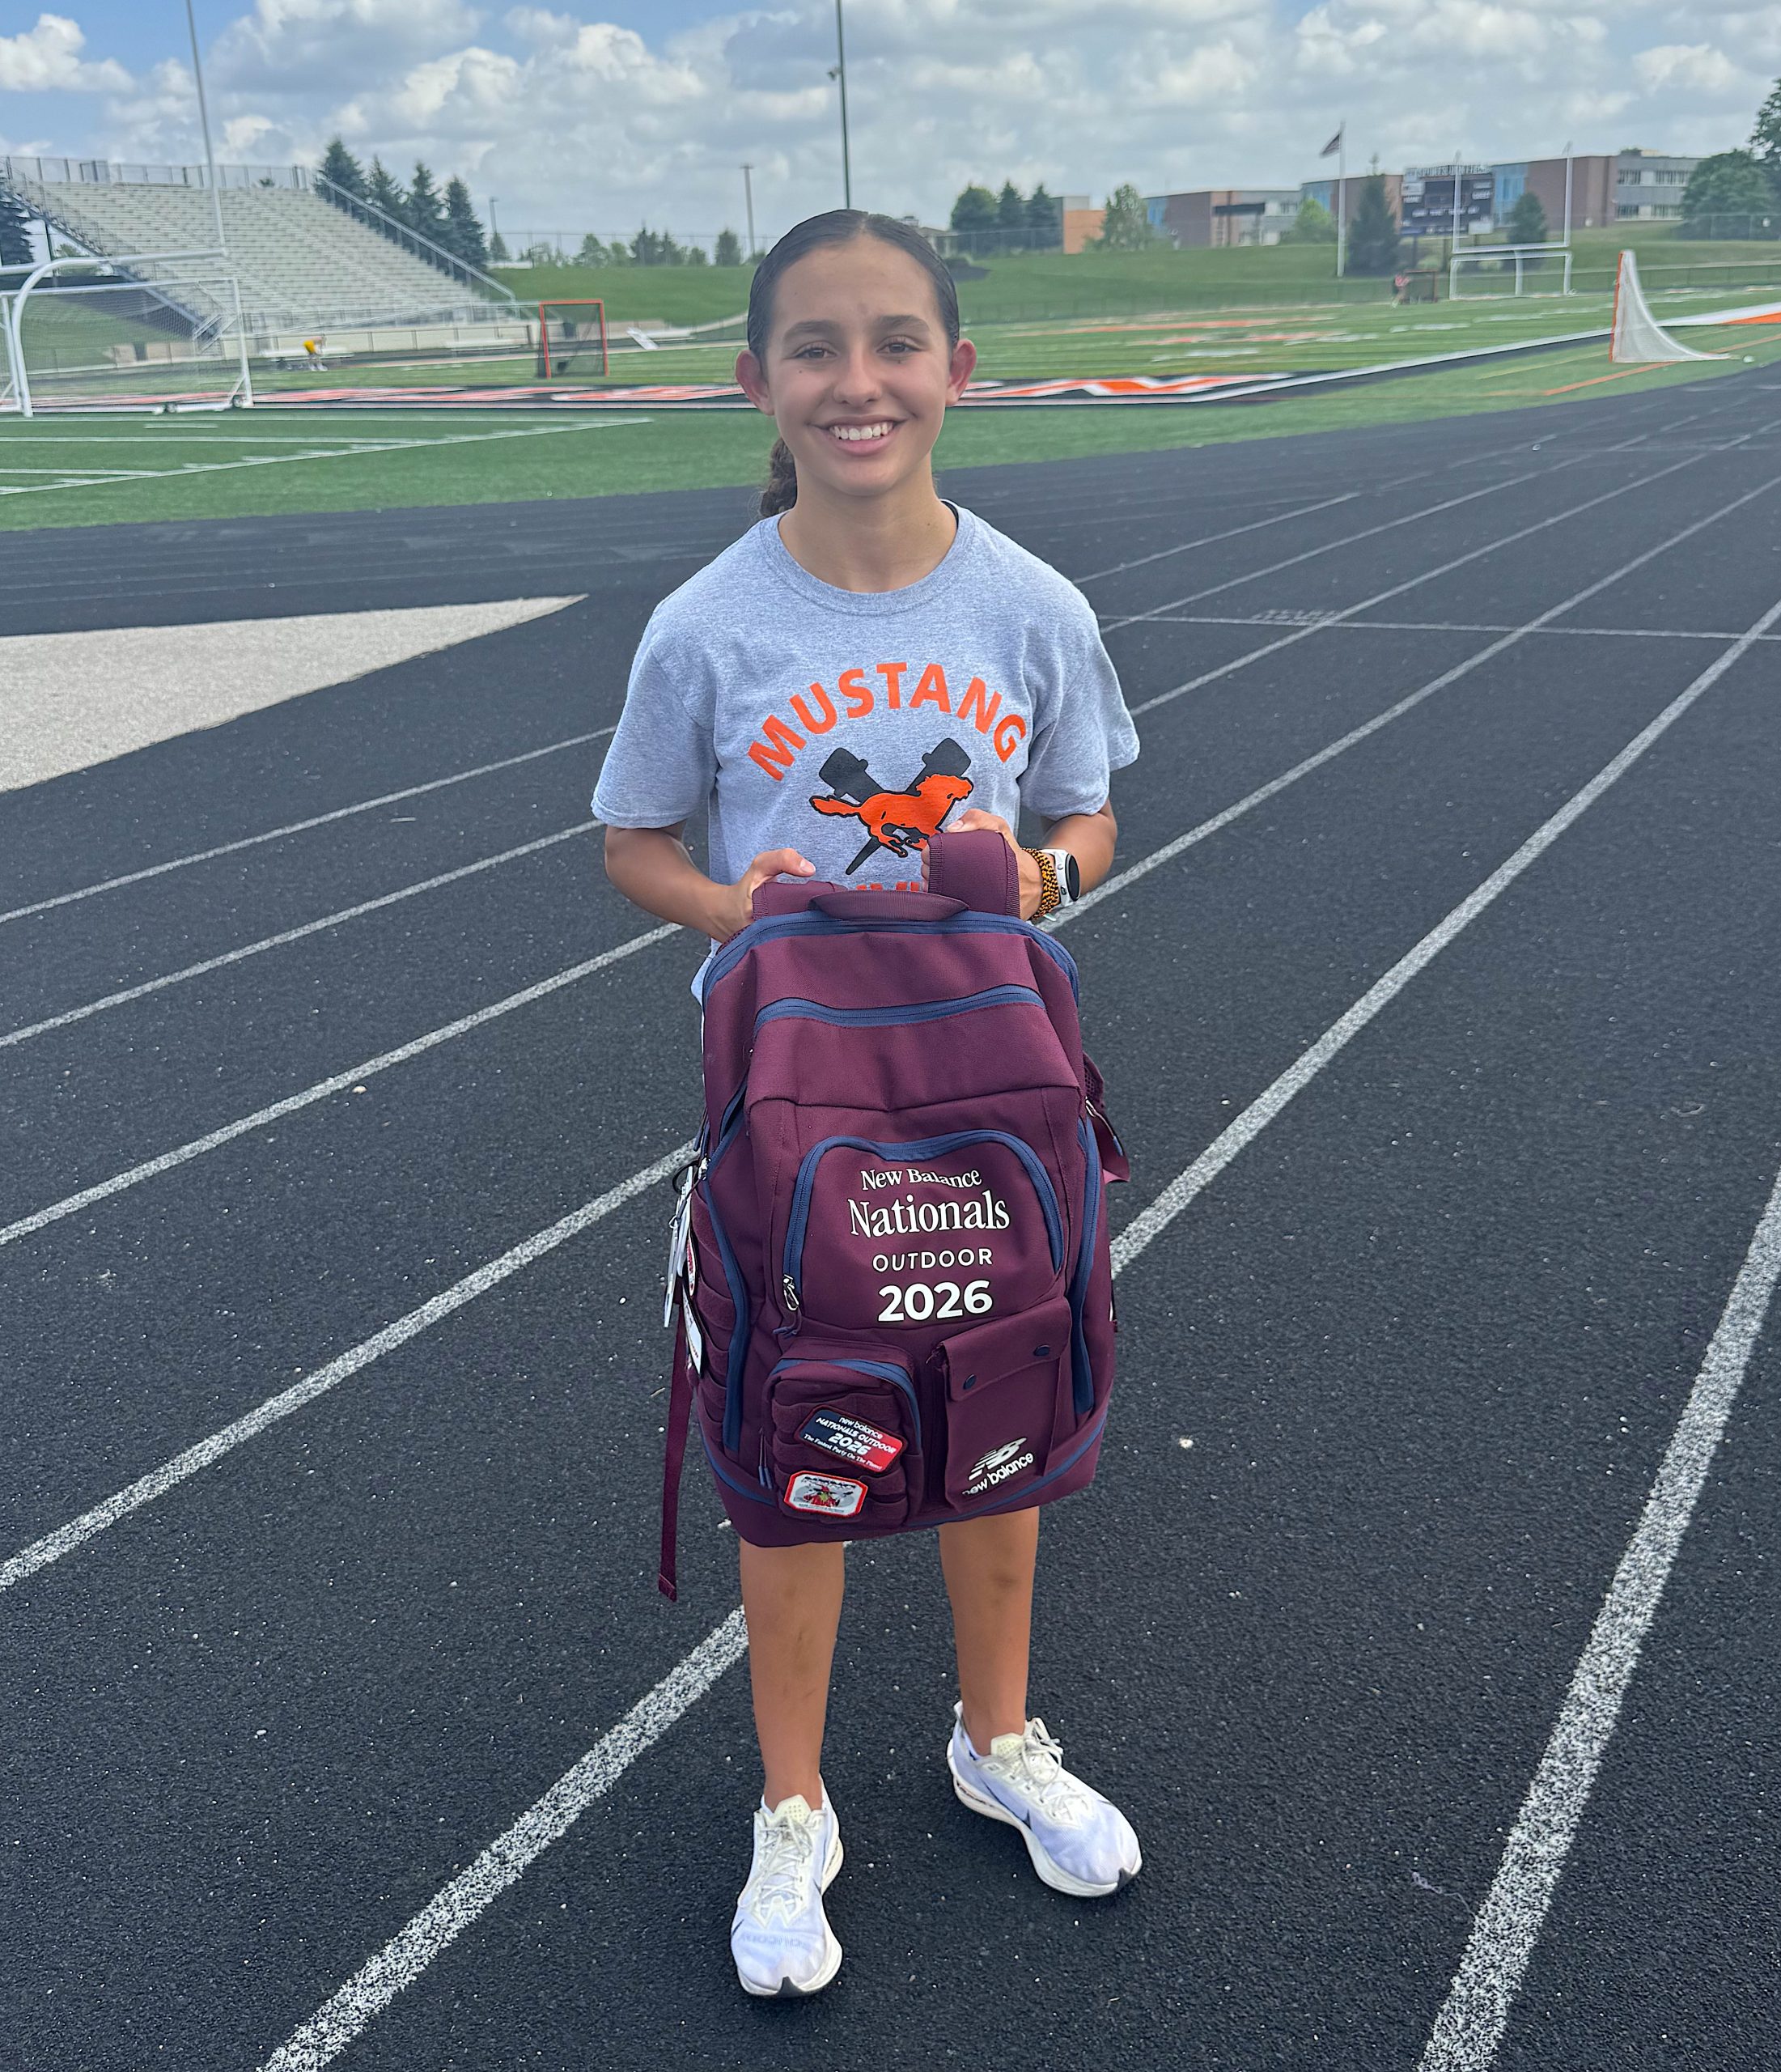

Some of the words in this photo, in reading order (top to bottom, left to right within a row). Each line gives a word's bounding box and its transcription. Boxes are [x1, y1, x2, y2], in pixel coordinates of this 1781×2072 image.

[748, 662, 1026, 782] MUSTANG
[861, 1170, 902, 1191] New
[906, 1169, 982, 1188] Balance
[848, 1190, 1010, 1238] Nationals
[872, 1248, 993, 1272] OUTDOOR
[878, 1280, 993, 1322] 2026
[816, 1417, 859, 1437] NATIONALS
[858, 1434, 897, 1454] OUTDOOR
[829, 1433, 871, 1455] 2026
[839, 1417, 854, 1426] new
[854, 1421, 883, 1439] balance
[986, 1453, 1033, 1485] balance
